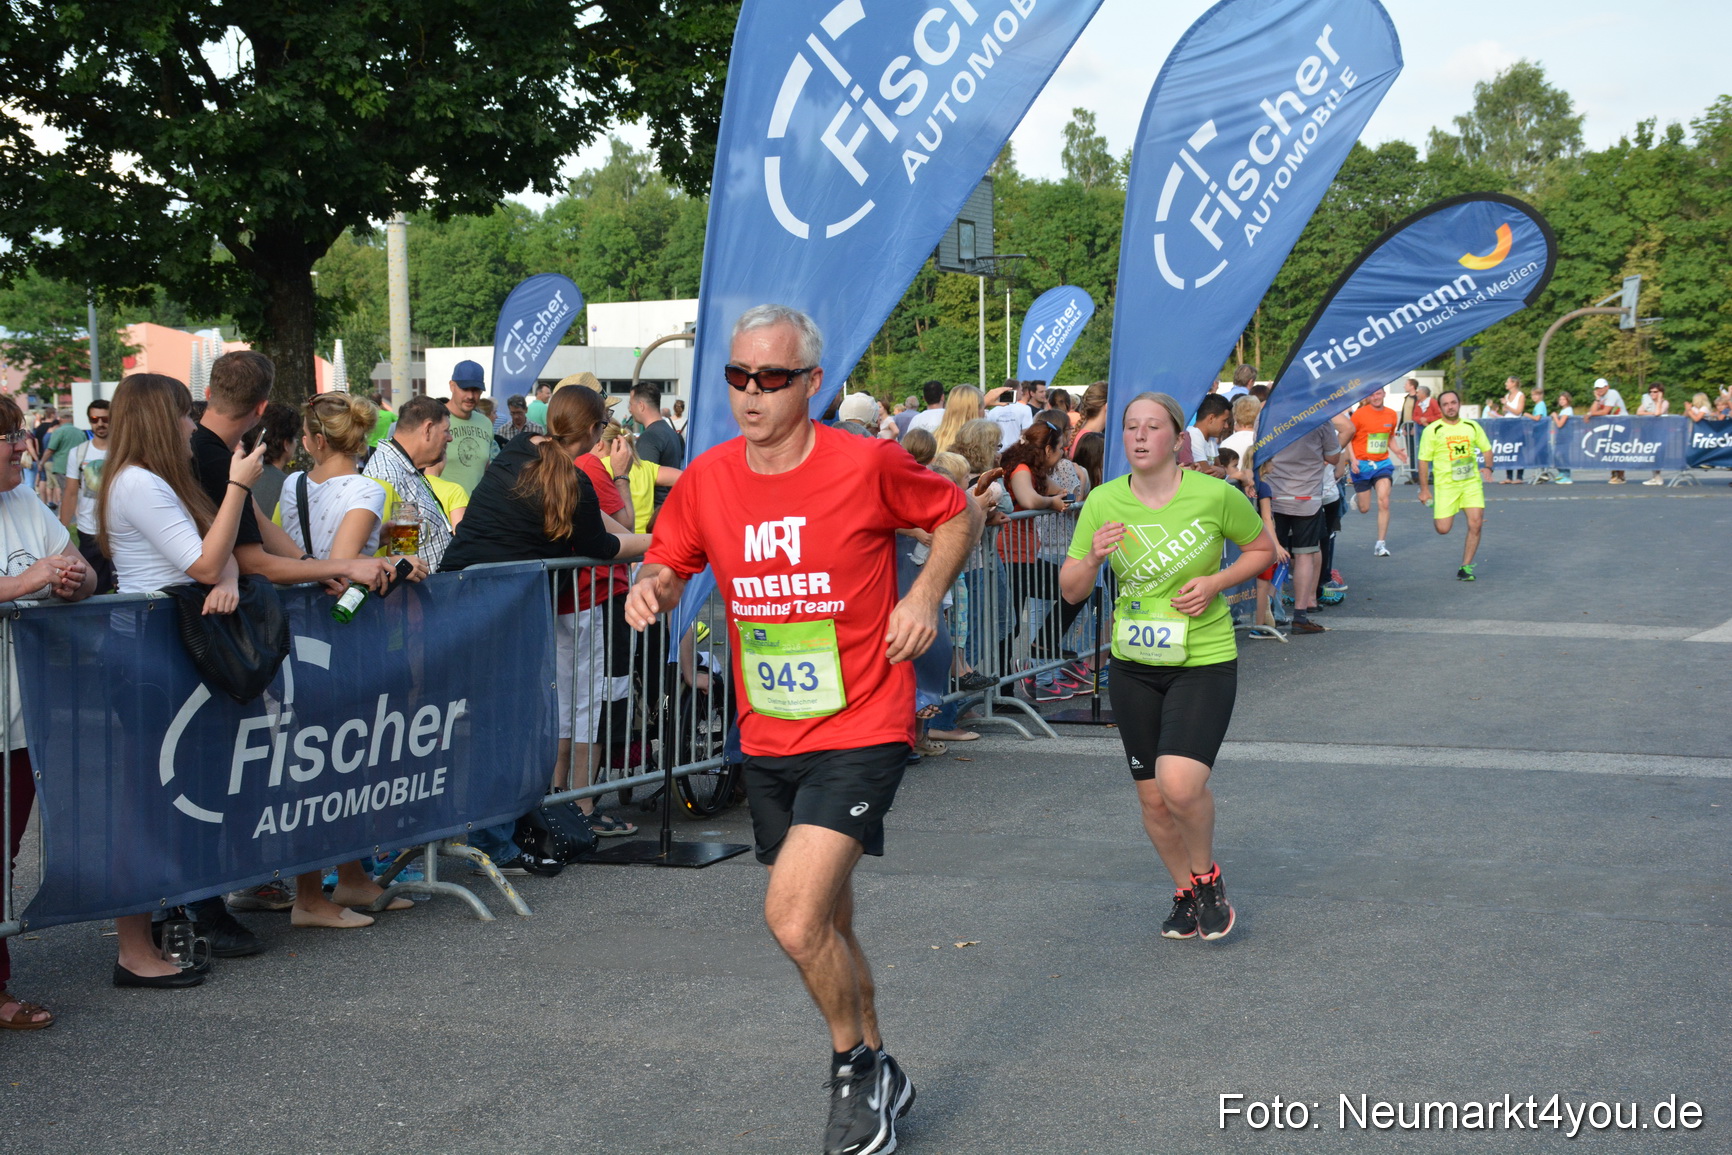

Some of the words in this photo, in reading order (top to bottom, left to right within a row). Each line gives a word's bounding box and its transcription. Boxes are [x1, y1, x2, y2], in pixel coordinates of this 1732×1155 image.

[1190, 24, 1340, 251] Fischer
[1243, 66, 1358, 247] AUTOMOBILE
[514, 289, 564, 362] Fischer
[1303, 274, 1477, 379] Frischmann
[1415, 305, 1458, 335] Druck
[1459, 290, 1487, 311] und
[1486, 260, 1539, 298] Medien
[531, 304, 570, 361] AUTOMOBILE
[1036, 299, 1078, 360] Fischer
[1051, 309, 1083, 359] AUTOMOBILE
[449, 425, 490, 443] PRINGFIELD
[1251, 378, 1361, 453] www.frischmann-net.de
[1595, 438, 1662, 454] Fischer
[744, 516, 806, 566] MRT
[1144, 580, 1158, 592] UND
[1158, 533, 1215, 583] GEBÄUDETECHNIK
[732, 572, 831, 598] MEIER
[732, 600, 792, 616] Running
[793, 599, 845, 614] Team
[1128, 624, 1171, 649] 202
[758, 661, 819, 692] 943
[228, 693, 466, 796] Fischer
[252, 767, 447, 839] AUTOMOBILE
